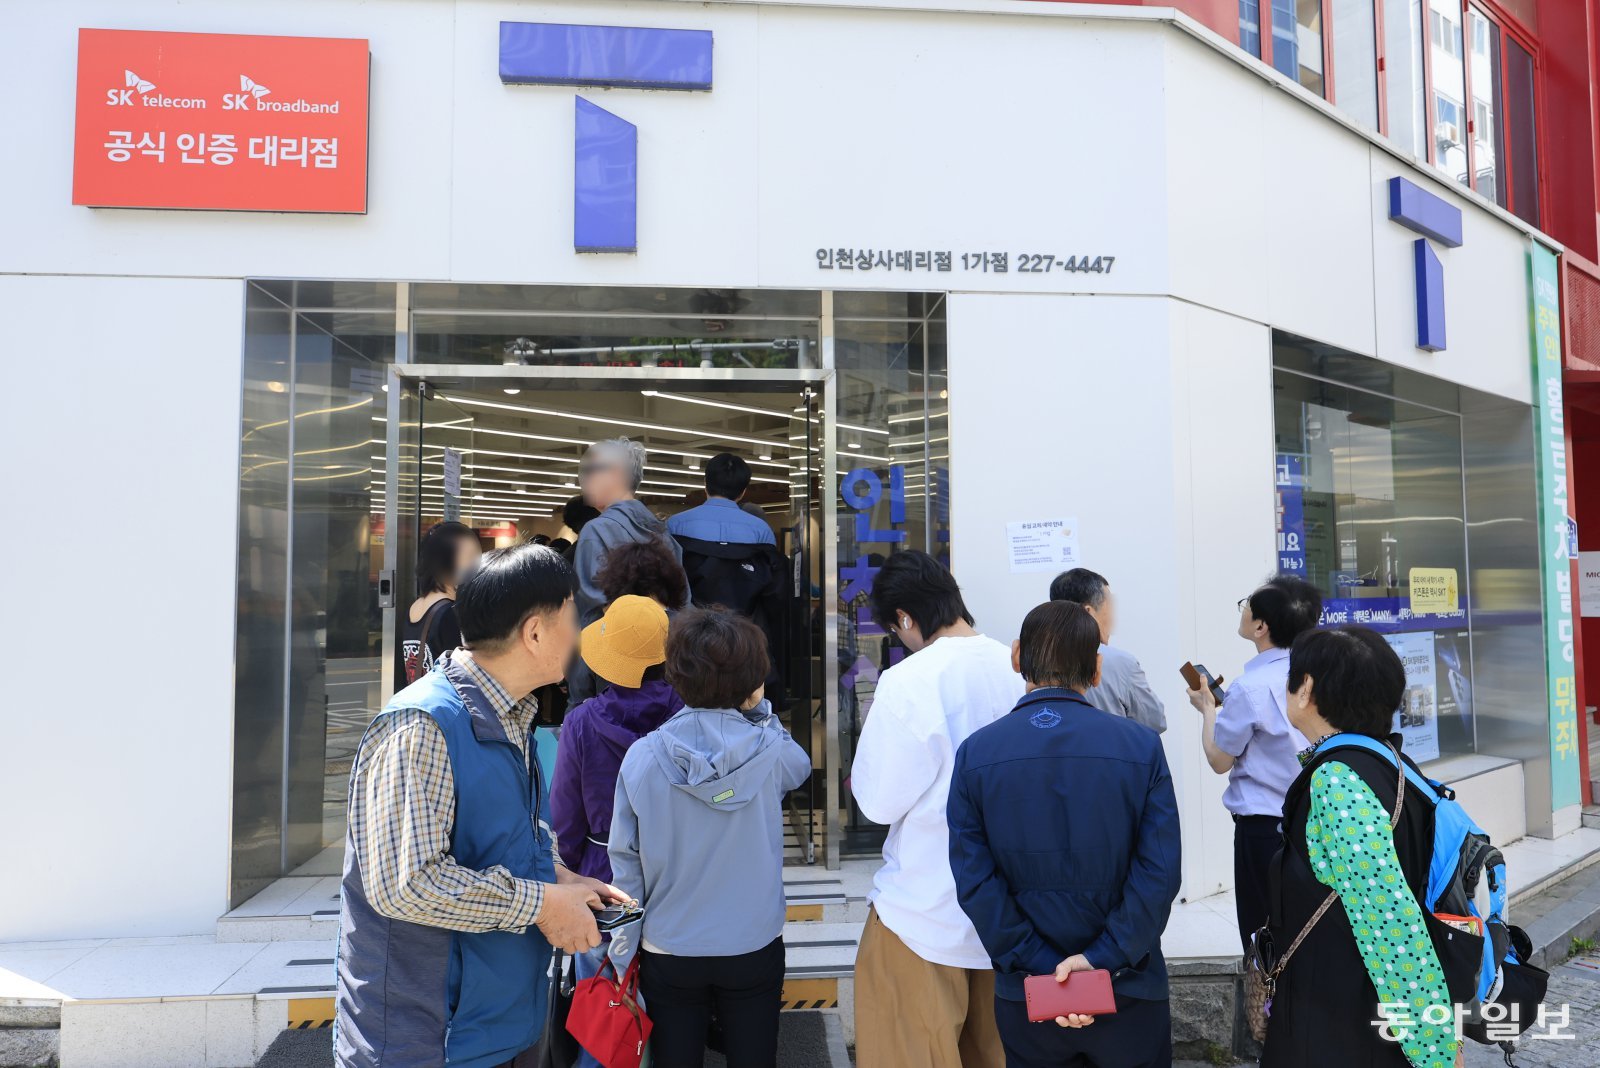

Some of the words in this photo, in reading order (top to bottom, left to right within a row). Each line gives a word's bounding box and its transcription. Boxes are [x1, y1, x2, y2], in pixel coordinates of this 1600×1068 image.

[106, 88, 135, 106] SK
[142, 94, 207, 109] telecom
[221, 93, 249, 111] SK
[256, 99, 339, 114] broadband
[103, 130, 166, 164] 공식
[176, 132, 239, 166] 인증
[248, 135, 338, 169] 대리점
[815, 247, 952, 272] 인천상사대리점
[961, 251, 1009, 273] 1가점
[1017, 253, 1116, 274] 227-4447
[1326, 611, 1347, 625] MORE
